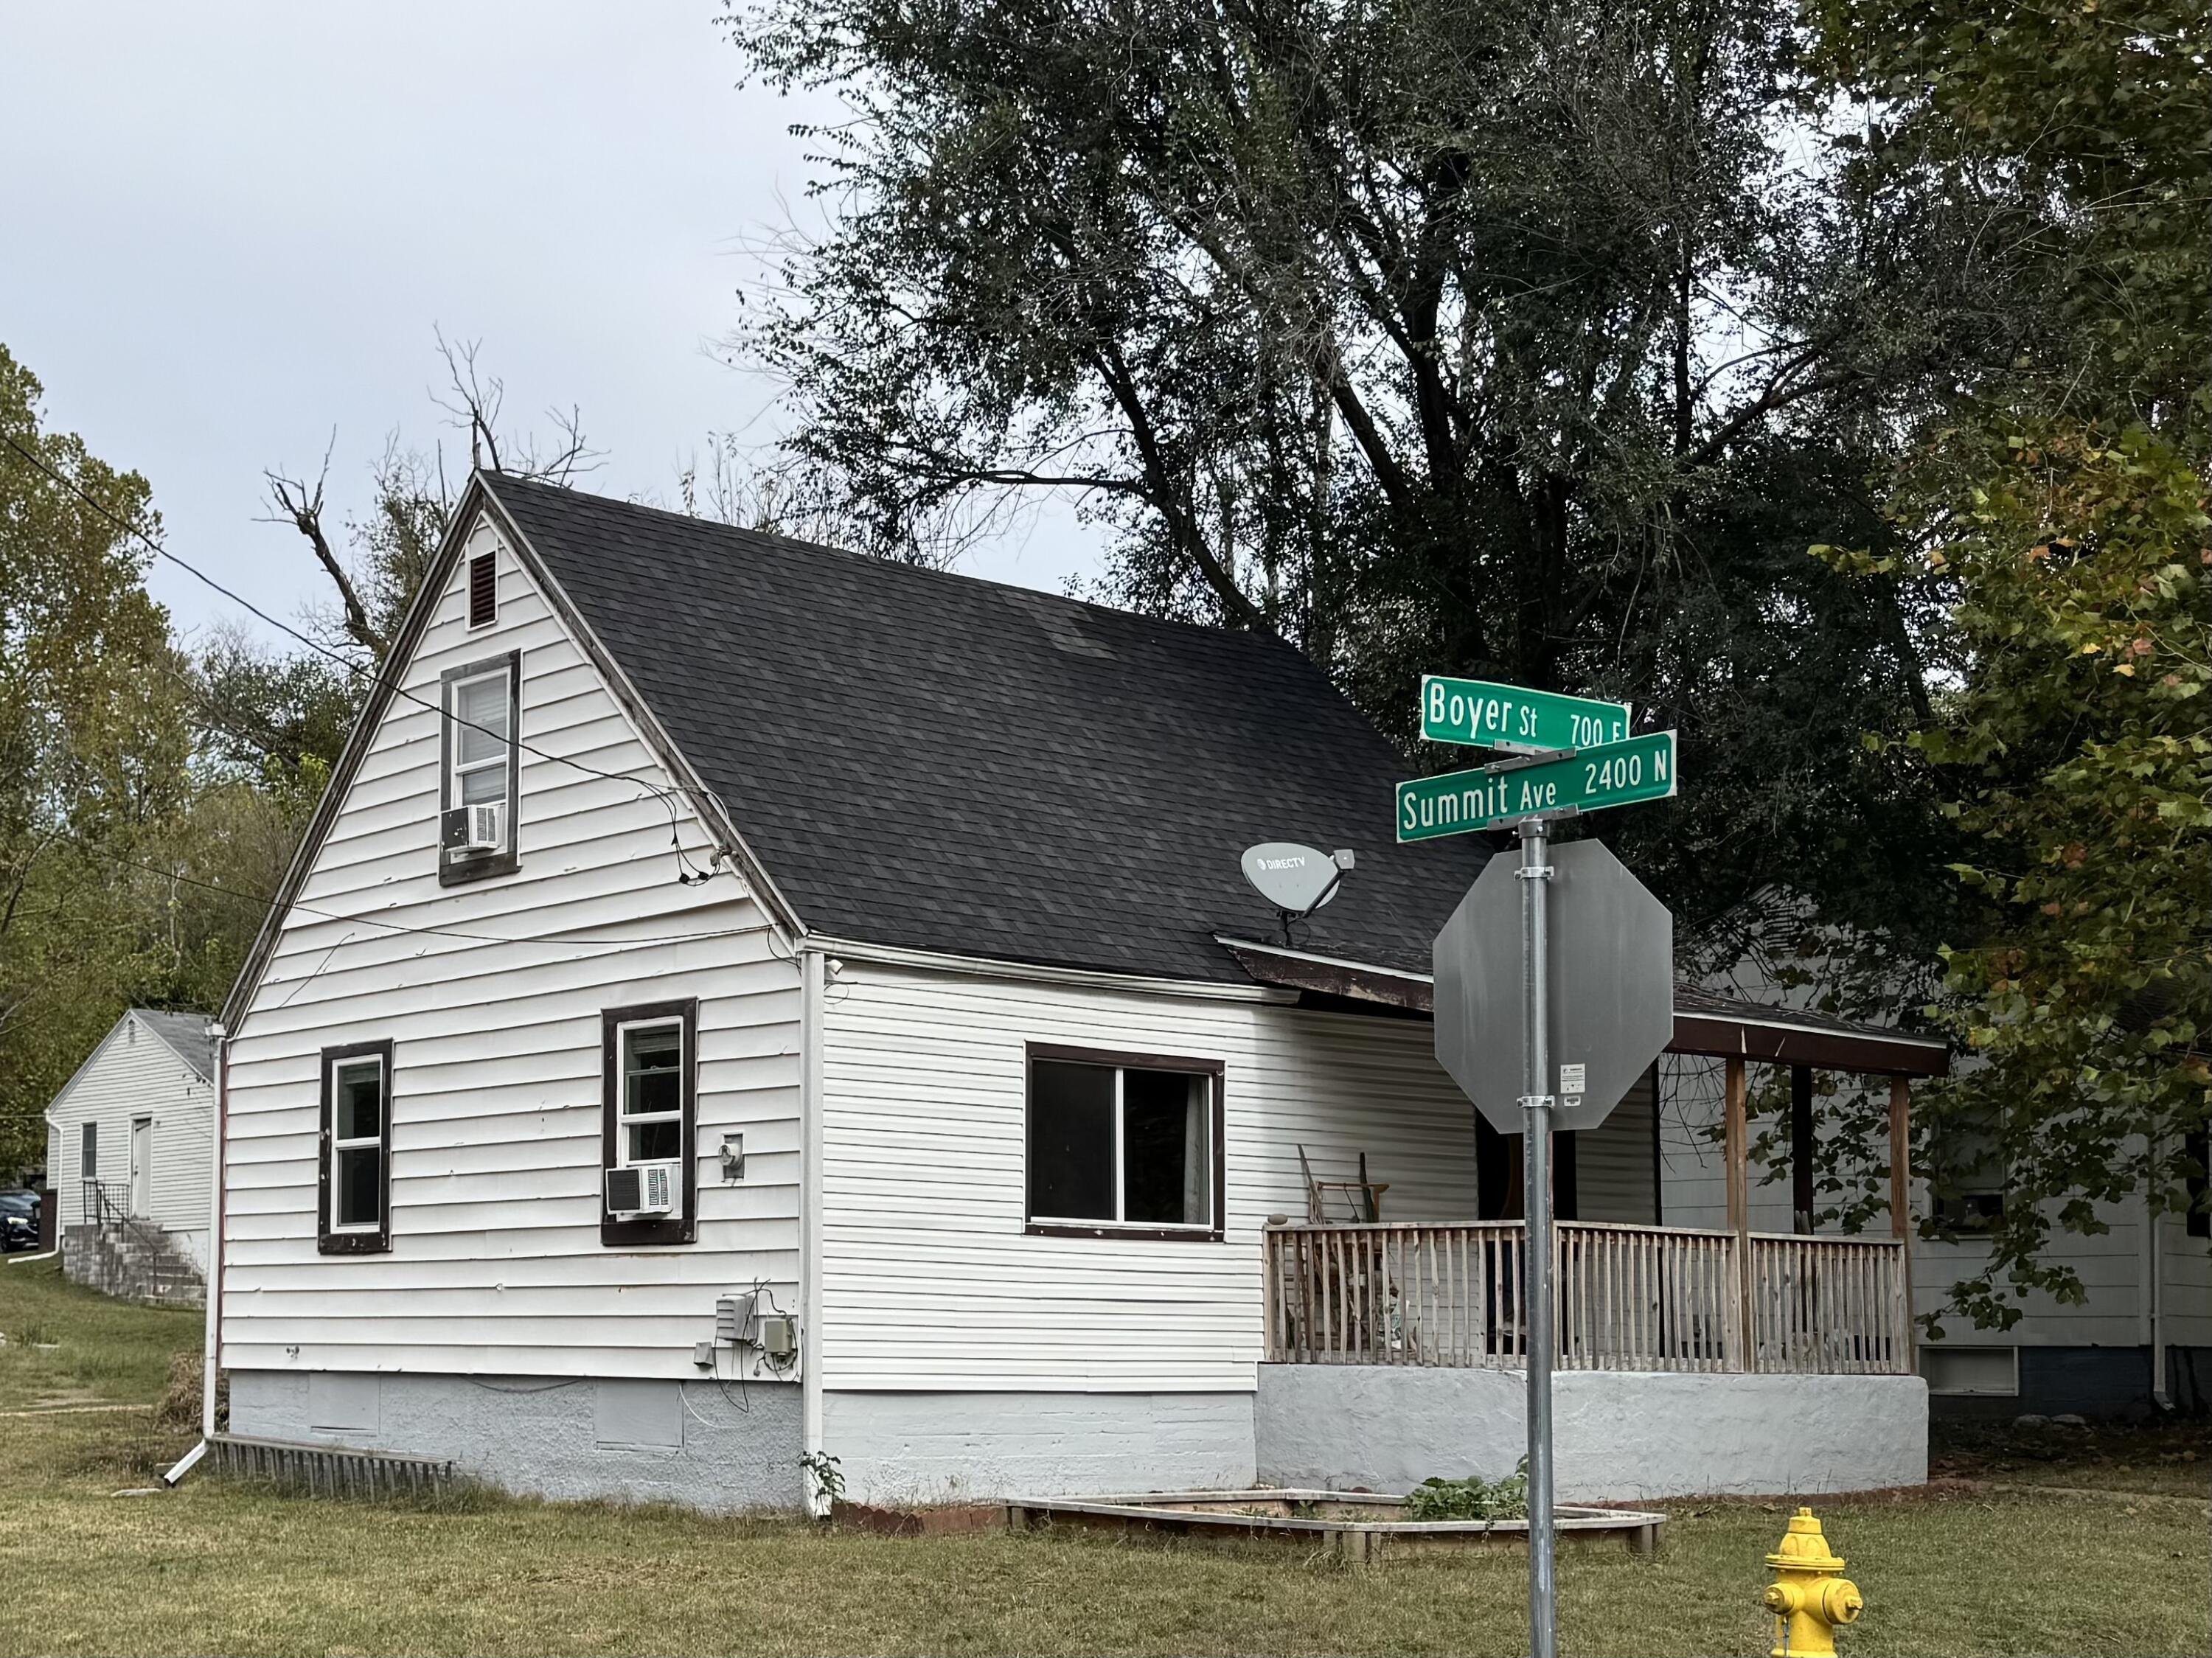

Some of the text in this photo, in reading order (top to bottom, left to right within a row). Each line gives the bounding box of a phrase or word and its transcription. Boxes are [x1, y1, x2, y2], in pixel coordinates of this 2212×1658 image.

[1430, 683, 1512, 739] Boyer
[1519, 705, 1537, 738] St
[1571, 714, 1603, 746] 700
[1403, 748, 1667, 830] Summit Ave 2400 N
[1267, 857, 1305, 869] DIRECTV
